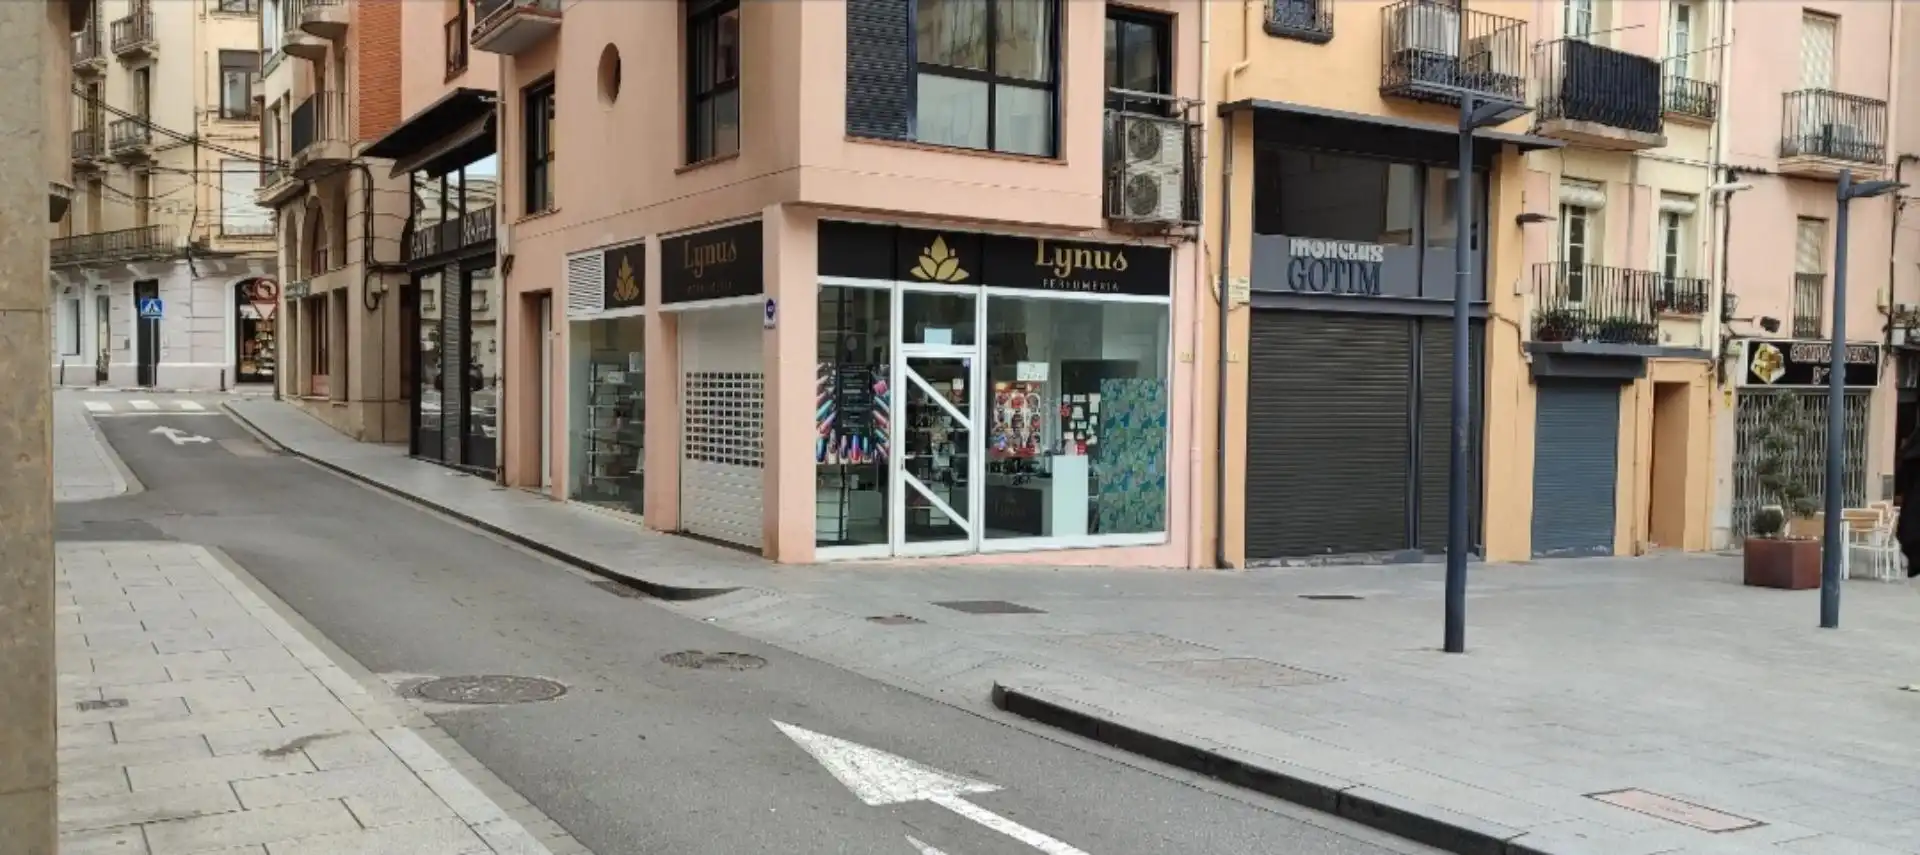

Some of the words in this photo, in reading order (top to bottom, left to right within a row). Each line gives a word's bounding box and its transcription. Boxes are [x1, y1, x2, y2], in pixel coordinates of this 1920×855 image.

[684, 238, 737, 278] Lynus
[1036, 239, 1128, 278] Lynus
[1287, 257, 1382, 294] GOTIM
